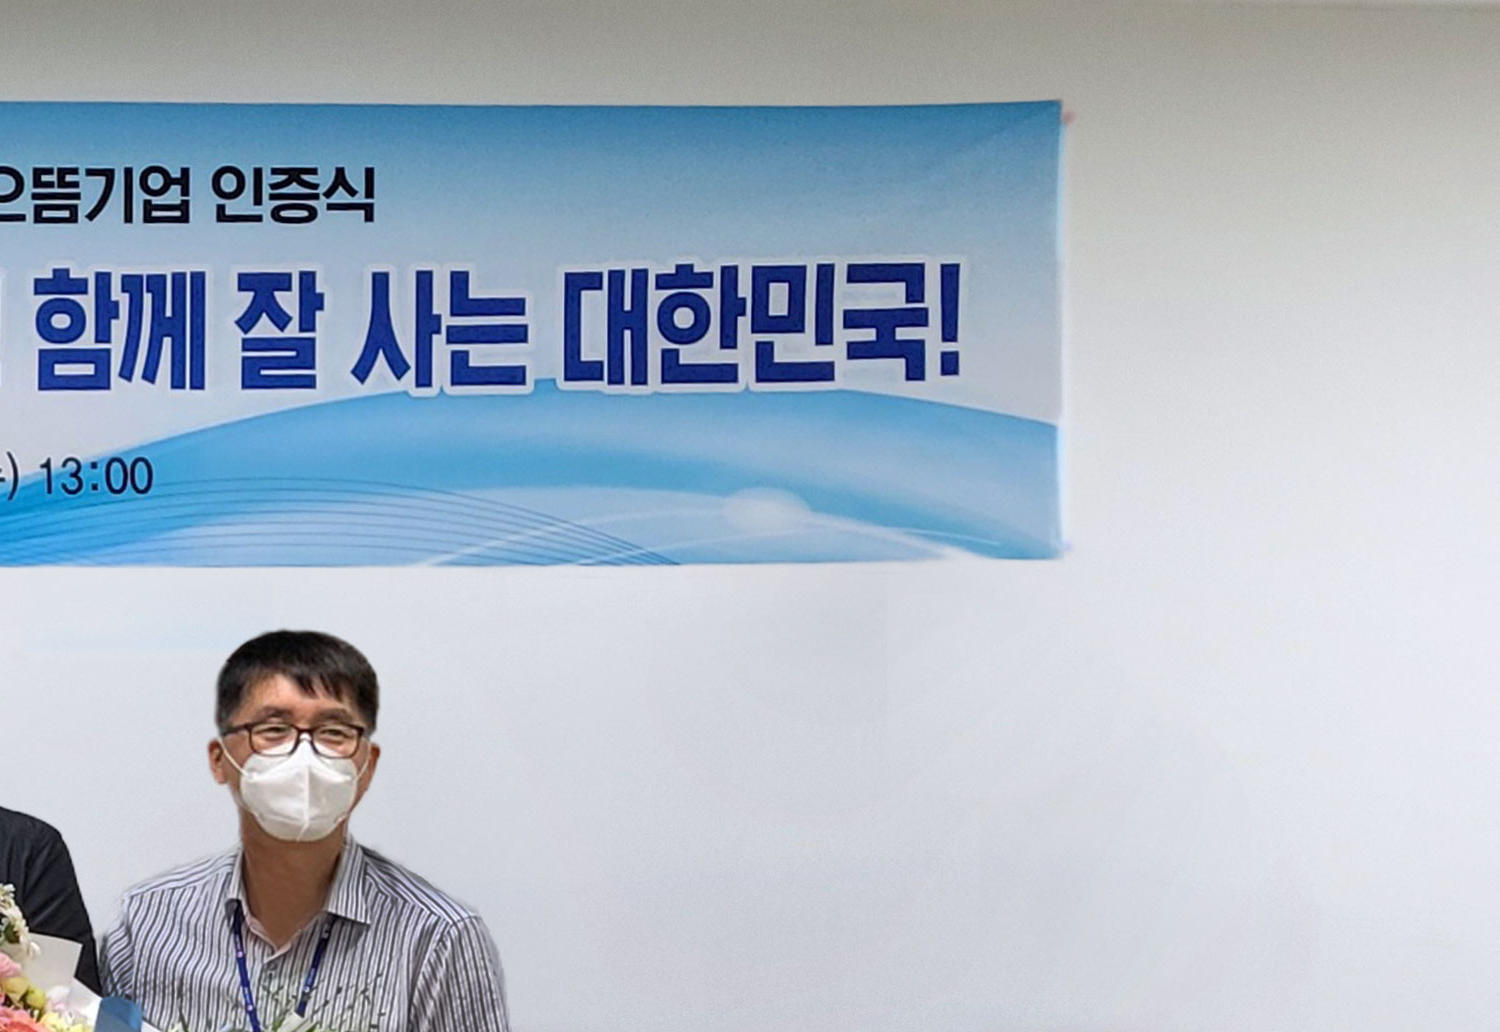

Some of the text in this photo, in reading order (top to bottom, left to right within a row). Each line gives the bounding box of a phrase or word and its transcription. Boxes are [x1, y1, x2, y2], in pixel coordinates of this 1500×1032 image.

[210, 164, 376, 225] 인증식
[33, 267, 207, 392] 함께
[233, 270, 326, 391] 잘
[350, 269, 530, 388] 사는
[562, 261, 962, 387] 대한민국!
[39, 455, 155, 496] 13:00
